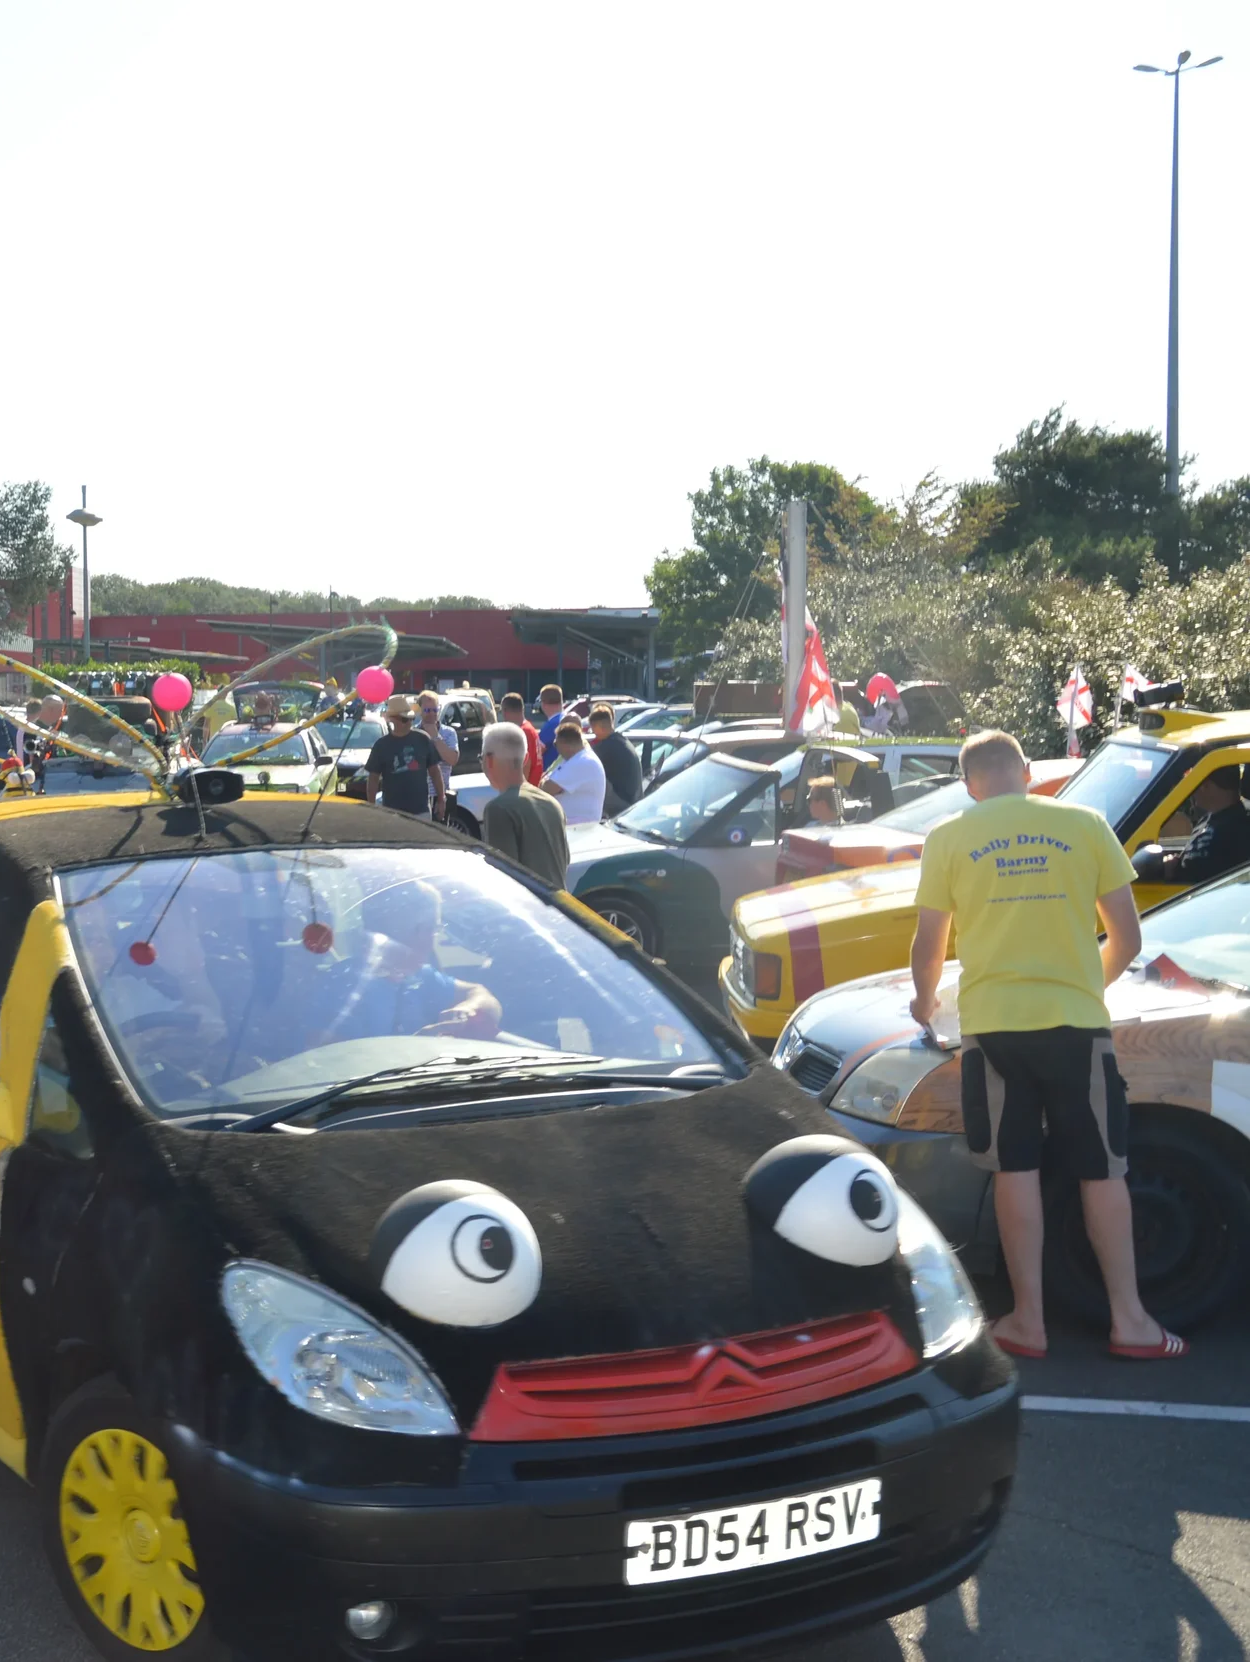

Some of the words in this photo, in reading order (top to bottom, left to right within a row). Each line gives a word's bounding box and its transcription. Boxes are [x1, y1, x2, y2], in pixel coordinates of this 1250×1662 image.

[969, 837, 1011, 863] Rally
[1016, 833, 1072, 853] Driver
[995, 855, 1048, 869] Barmy
[650, 1508, 769, 1572] BD54
[785, 1488, 862, 1550] RSV
